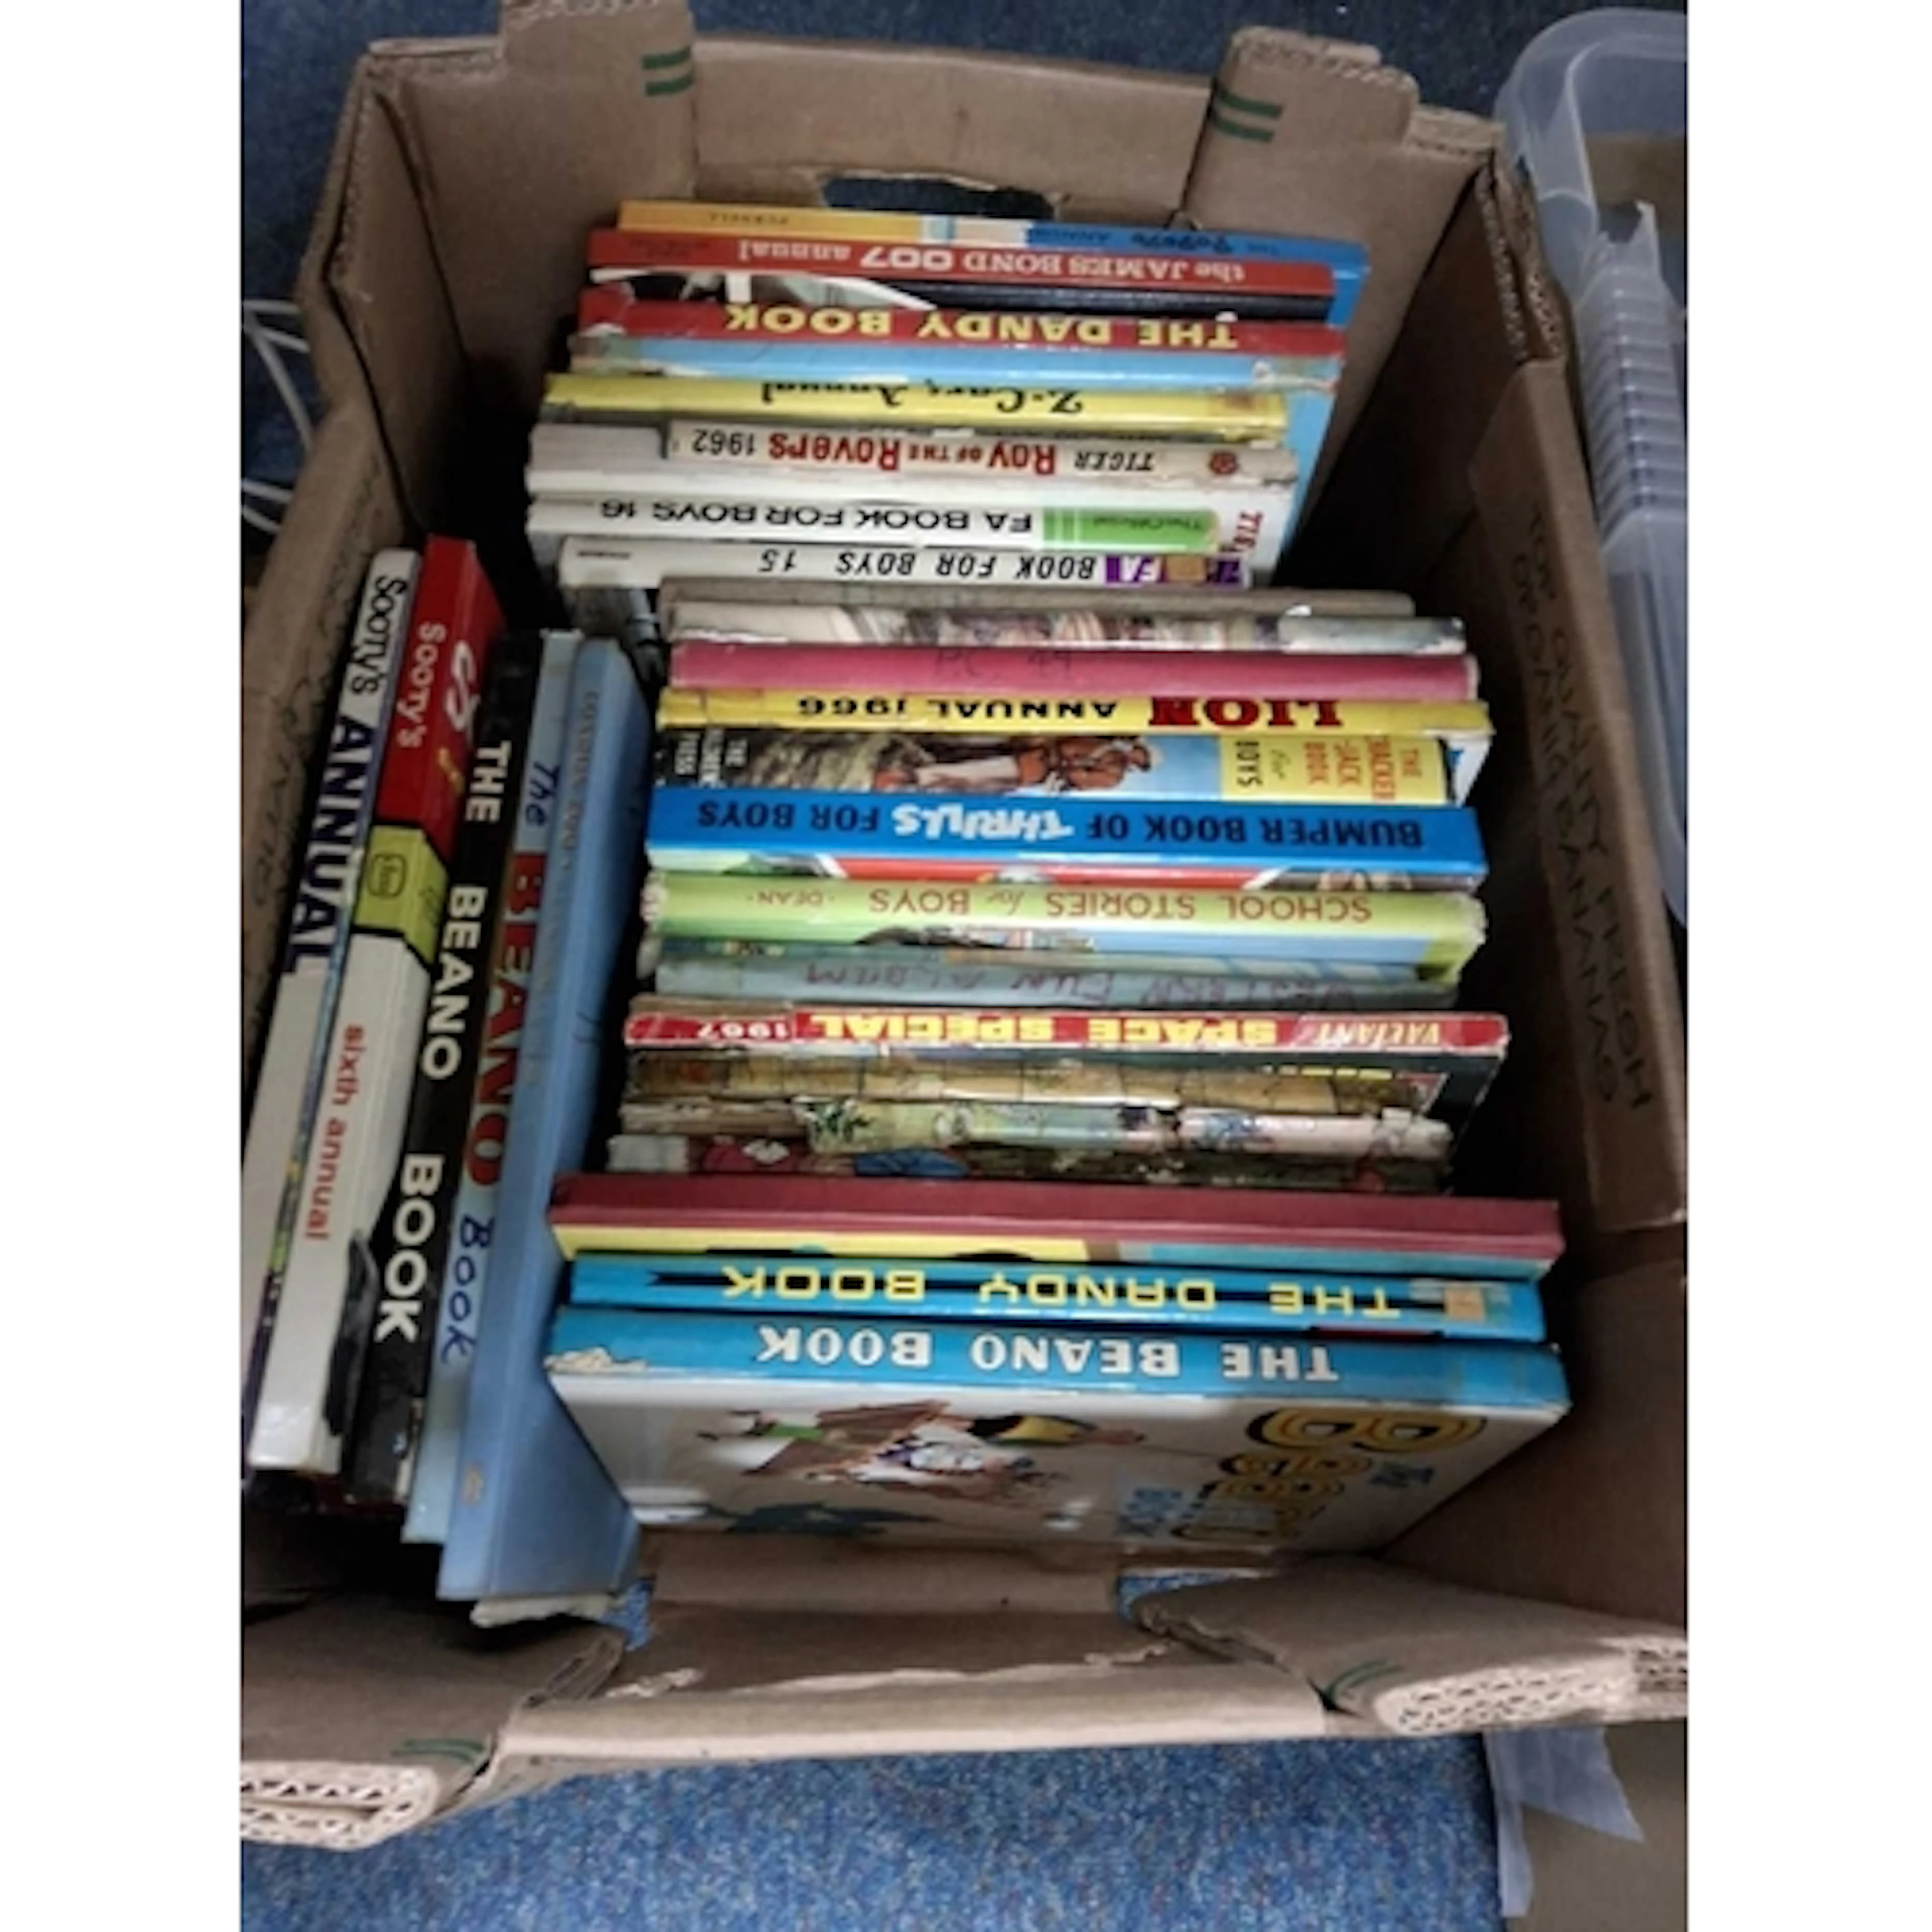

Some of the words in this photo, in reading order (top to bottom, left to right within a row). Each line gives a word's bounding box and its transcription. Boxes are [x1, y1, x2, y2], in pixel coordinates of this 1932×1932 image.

[738, 238, 852, 262] annual
[859, 246, 954, 272] 007
[962, 250, 1063, 277] BOND
[1069, 253, 1191, 281] JAMES
[1194, 262, 1246, 283] the
[723, 303, 892, 336] BOOK
[917, 308, 1112, 346] DANDY
[1137, 318, 1239, 349] THE
[692, 428, 756, 455] 1962
[768, 432, 902, 472] Rovers
[908, 443, 952, 460] THE
[1073, 451, 1157, 472] TIGER
[600, 500, 636, 520] 16
[654, 501, 756, 524] BOYS
[766, 504, 844, 529] FOR
[856, 506, 970, 530] BOOK
[984, 512, 1032, 533] FA
[758, 547, 797, 574] 15
[835, 549, 916, 576] BOYS
[935, 553, 997, 579] FOR
[1016, 554, 1097, 581] BOOK
[1119, 555, 1159, 584] FA
[797, 696, 909, 717] 1966
[926, 698, 1117, 719] ANNUAL
[1148, 696, 1343, 728] LION
[464, 740, 513, 824] THE
[524, 761, 561, 828] The
[697, 800, 795, 830] BOYS
[810, 801, 879, 833] FOR
[892, 802, 1075, 842] THRILLS
[1086, 814, 1130, 840] OF
[1144, 814, 1247, 843] BOOK
[281, 714, 376, 975] ANNUAL
[1260, 818, 1424, 849] BUMPER
[869, 887, 970, 915] BOYS
[1046, 891, 1195, 921] STORIES
[1222, 894, 1374, 923] SCHOOL
[422, 883, 489, 1080] BEANO
[464, 853, 547, 1186] BEANO
[811, 1013, 1055, 1043] SPECIAL
[1088, 1015, 1277, 1046] SPACE
[1314, 1020, 1441, 1046] VALIANT
[331, 1023, 367, 1107] sixth
[305, 1116, 348, 1241] annual
[374, 1152, 446, 1344] BOOK
[721, 1265, 926, 1302] BOOK
[978, 1272, 1216, 1310] DANDY
[1266, 1282, 1401, 1320] THE
[756, 1325, 932, 1368] BOOK
[971, 1333, 1181, 1378] BEANO
[1221, 1342, 1340, 1382] THE
